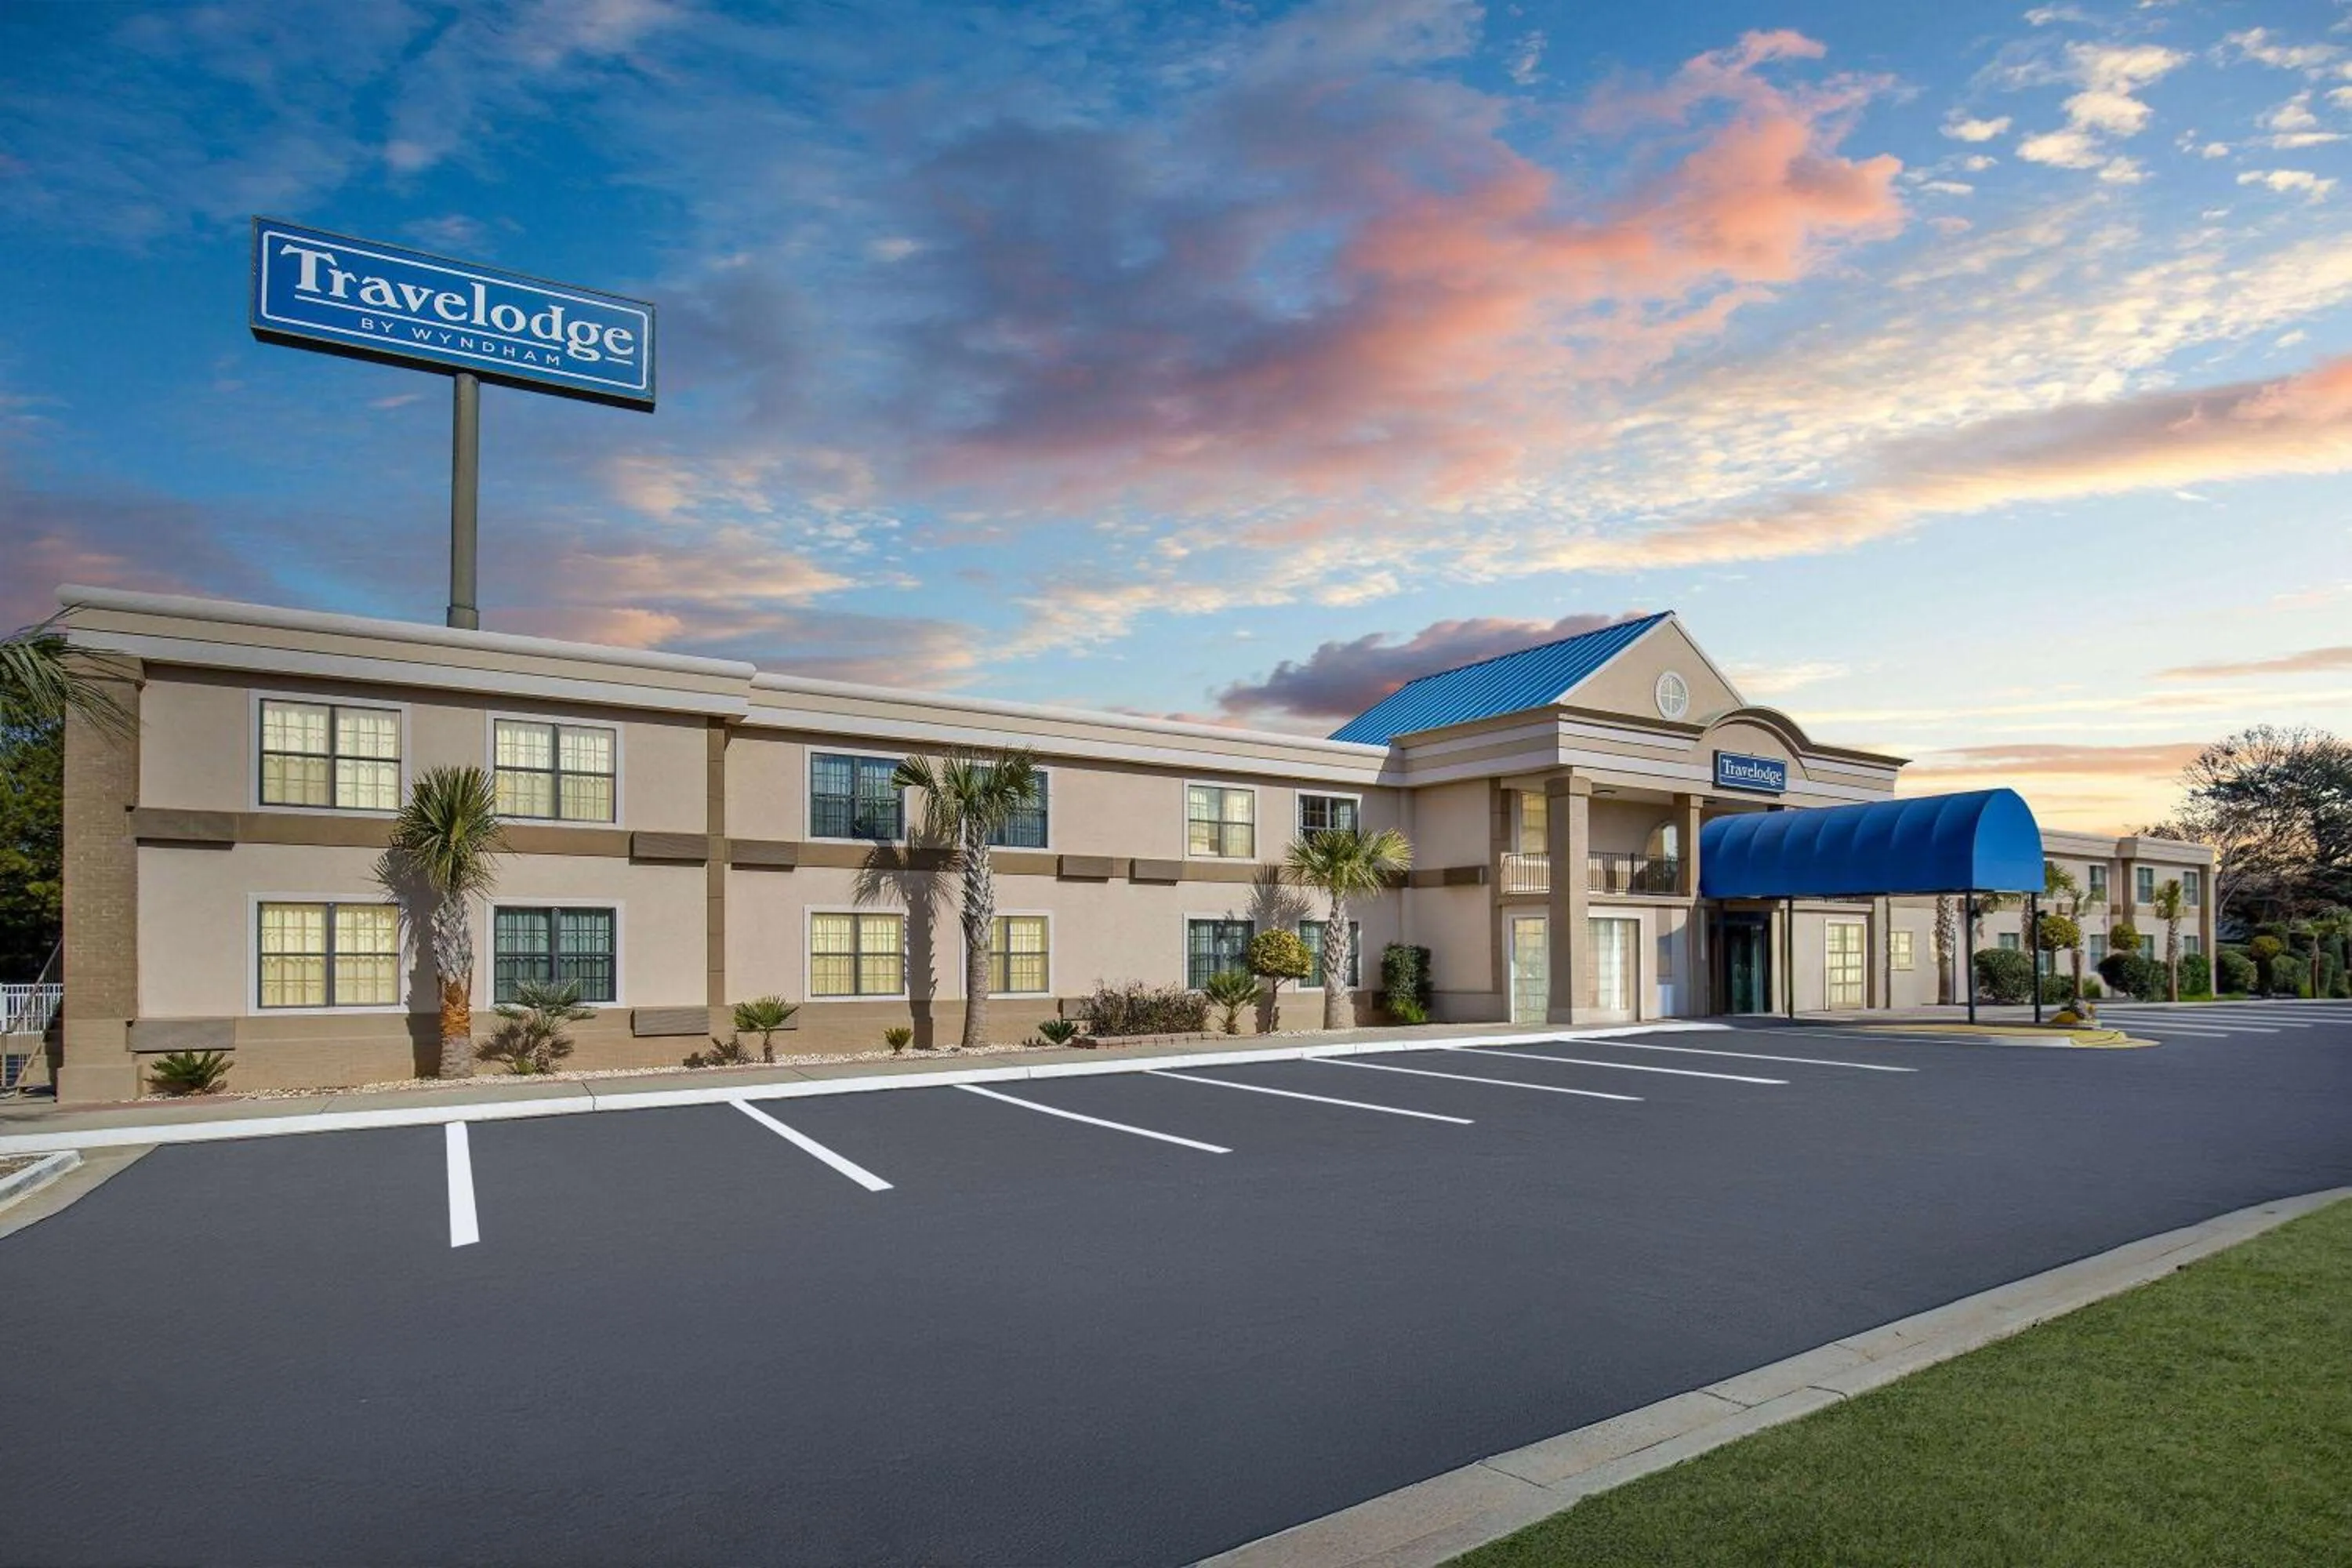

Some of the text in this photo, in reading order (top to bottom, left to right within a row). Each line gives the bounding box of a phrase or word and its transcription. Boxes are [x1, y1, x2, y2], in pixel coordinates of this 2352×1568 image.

[280, 244, 634, 361] Travelodge
[361, 317, 560, 366] BY WYNDHAM
[1722, 758, 1782, 786] Travelodge
